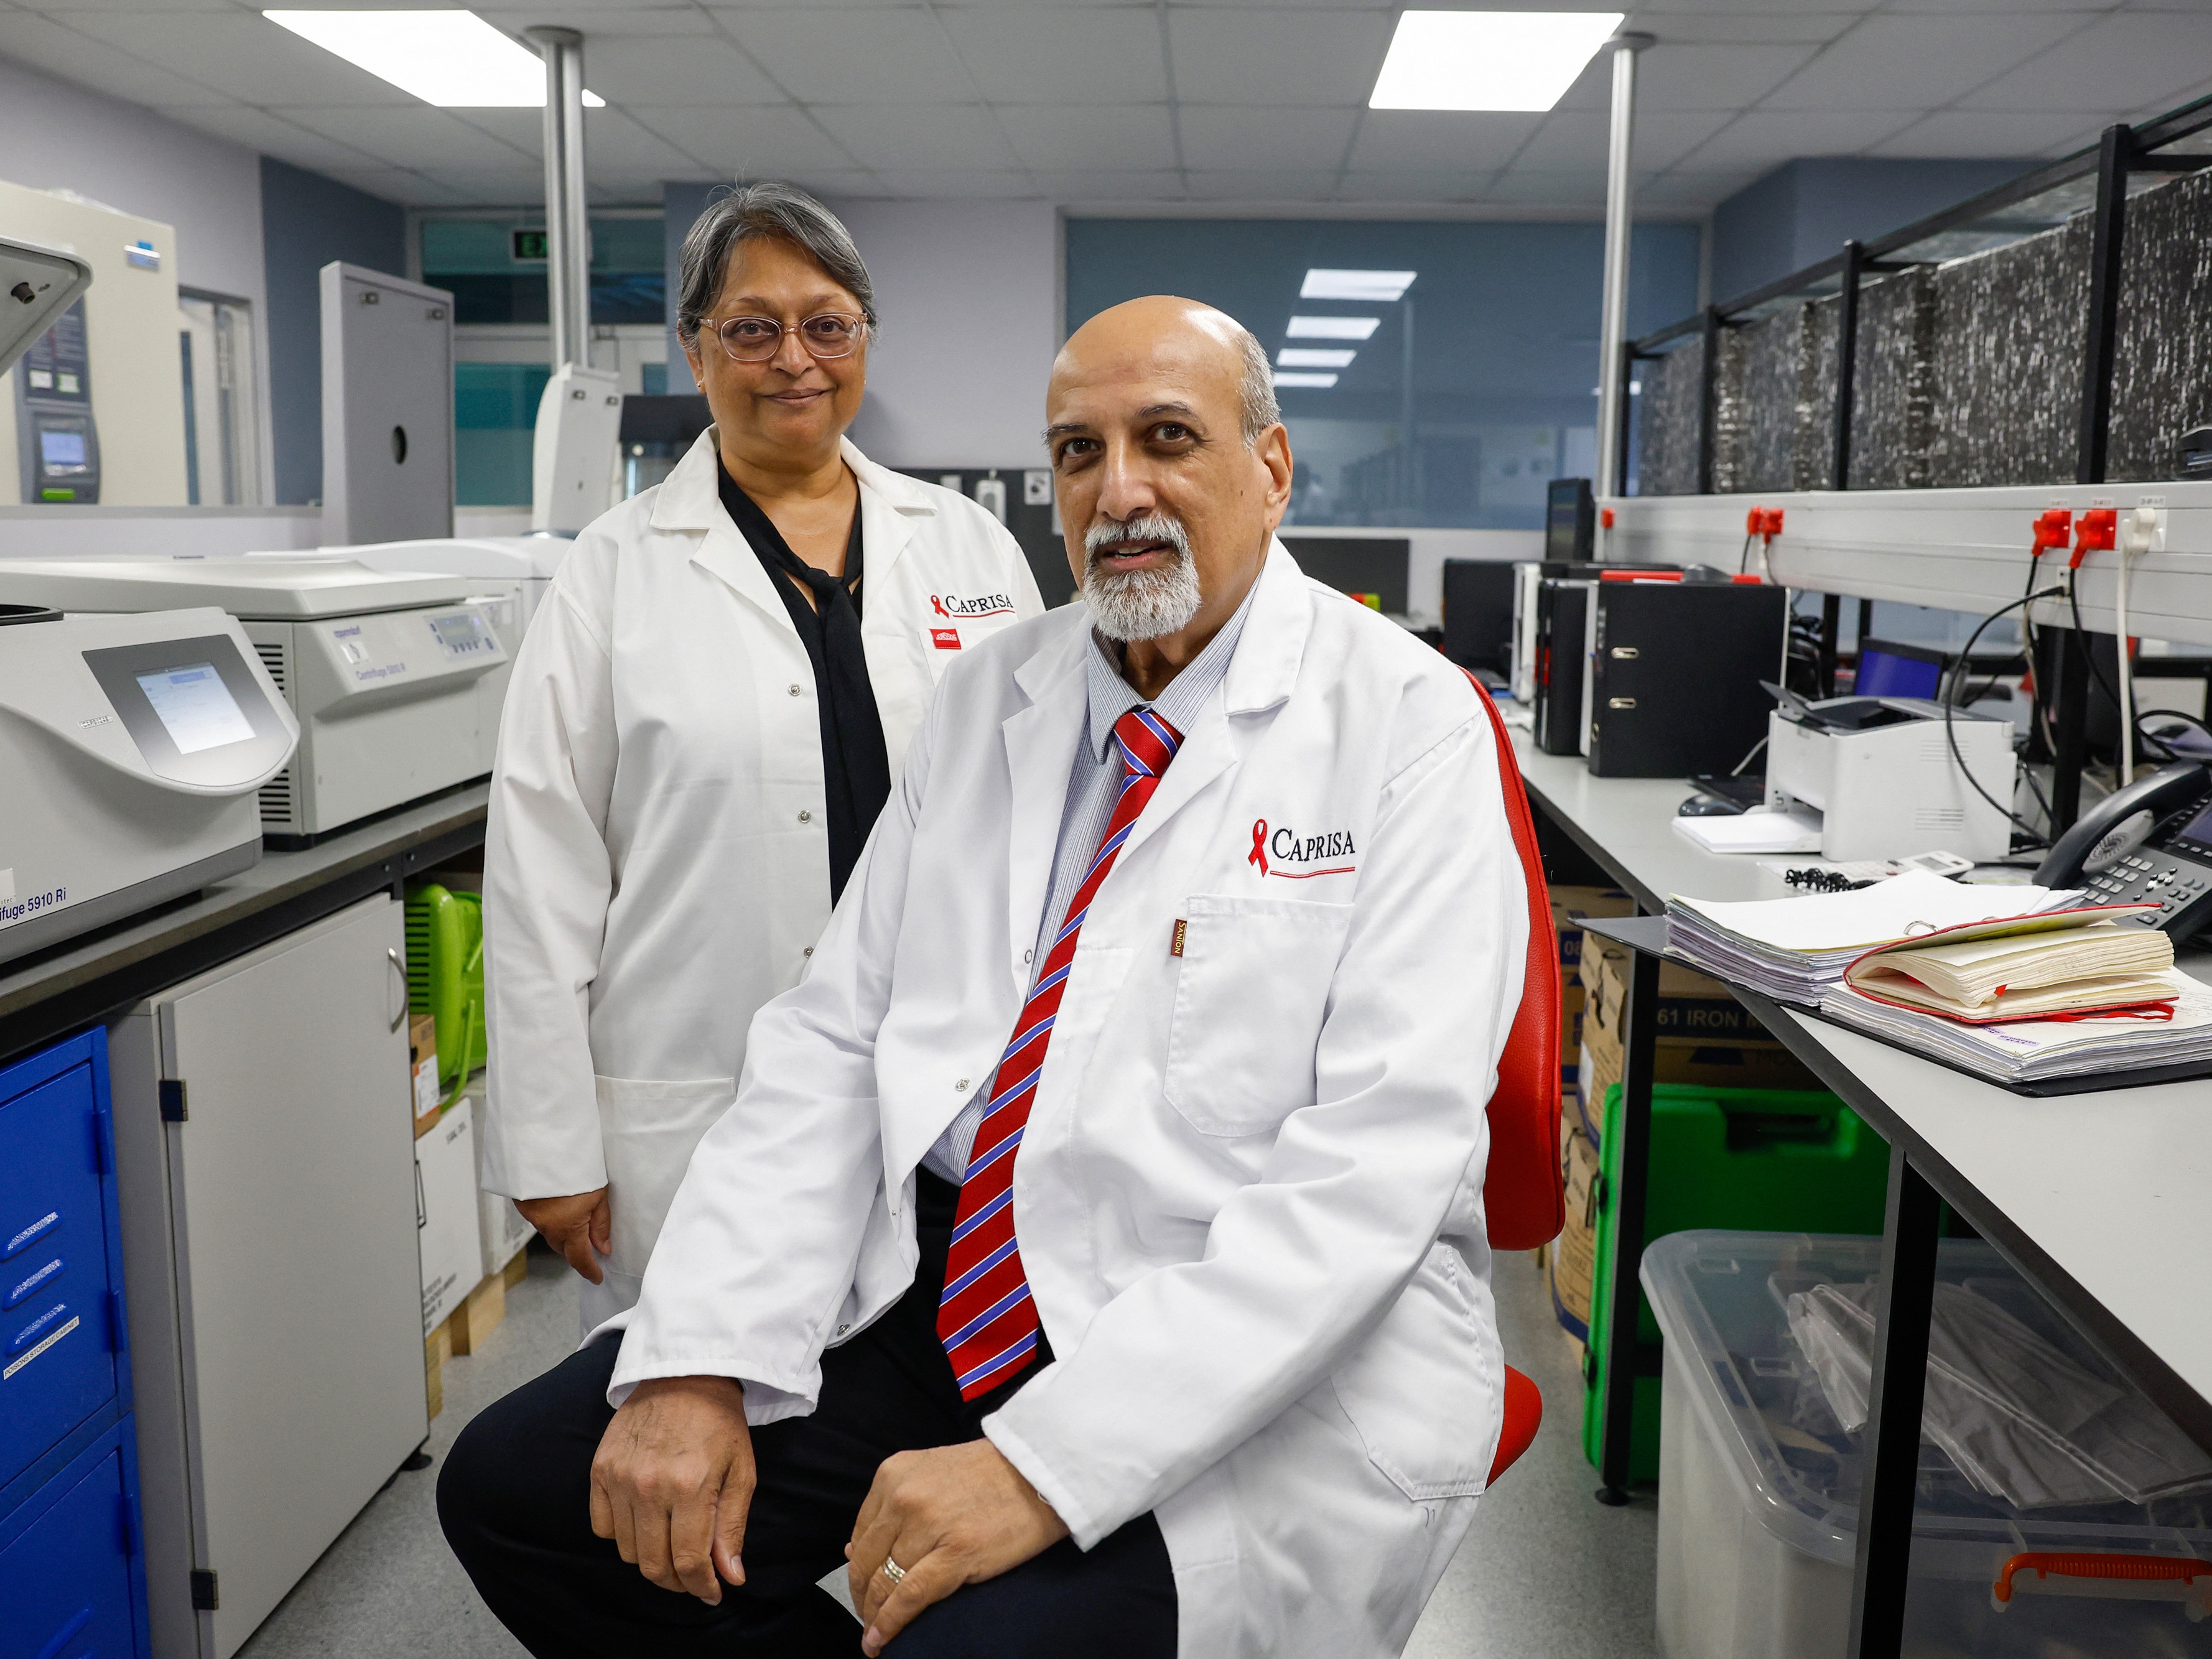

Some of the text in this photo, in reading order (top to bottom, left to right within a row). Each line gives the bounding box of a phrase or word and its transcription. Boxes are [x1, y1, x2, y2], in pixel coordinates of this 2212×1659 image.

[946, 593, 1014, 613] CAPRISA
[1272, 828, 1355, 862] CAPRISA
[28, 892, 52, 911] 5910
[56, 887, 66, 903] Ri
[1174, 922, 1186, 954] SANTON
[1686, 1010, 1739, 1027] IRON
[4, 1319, 78, 1377] POISONS STORAGE CABINET
